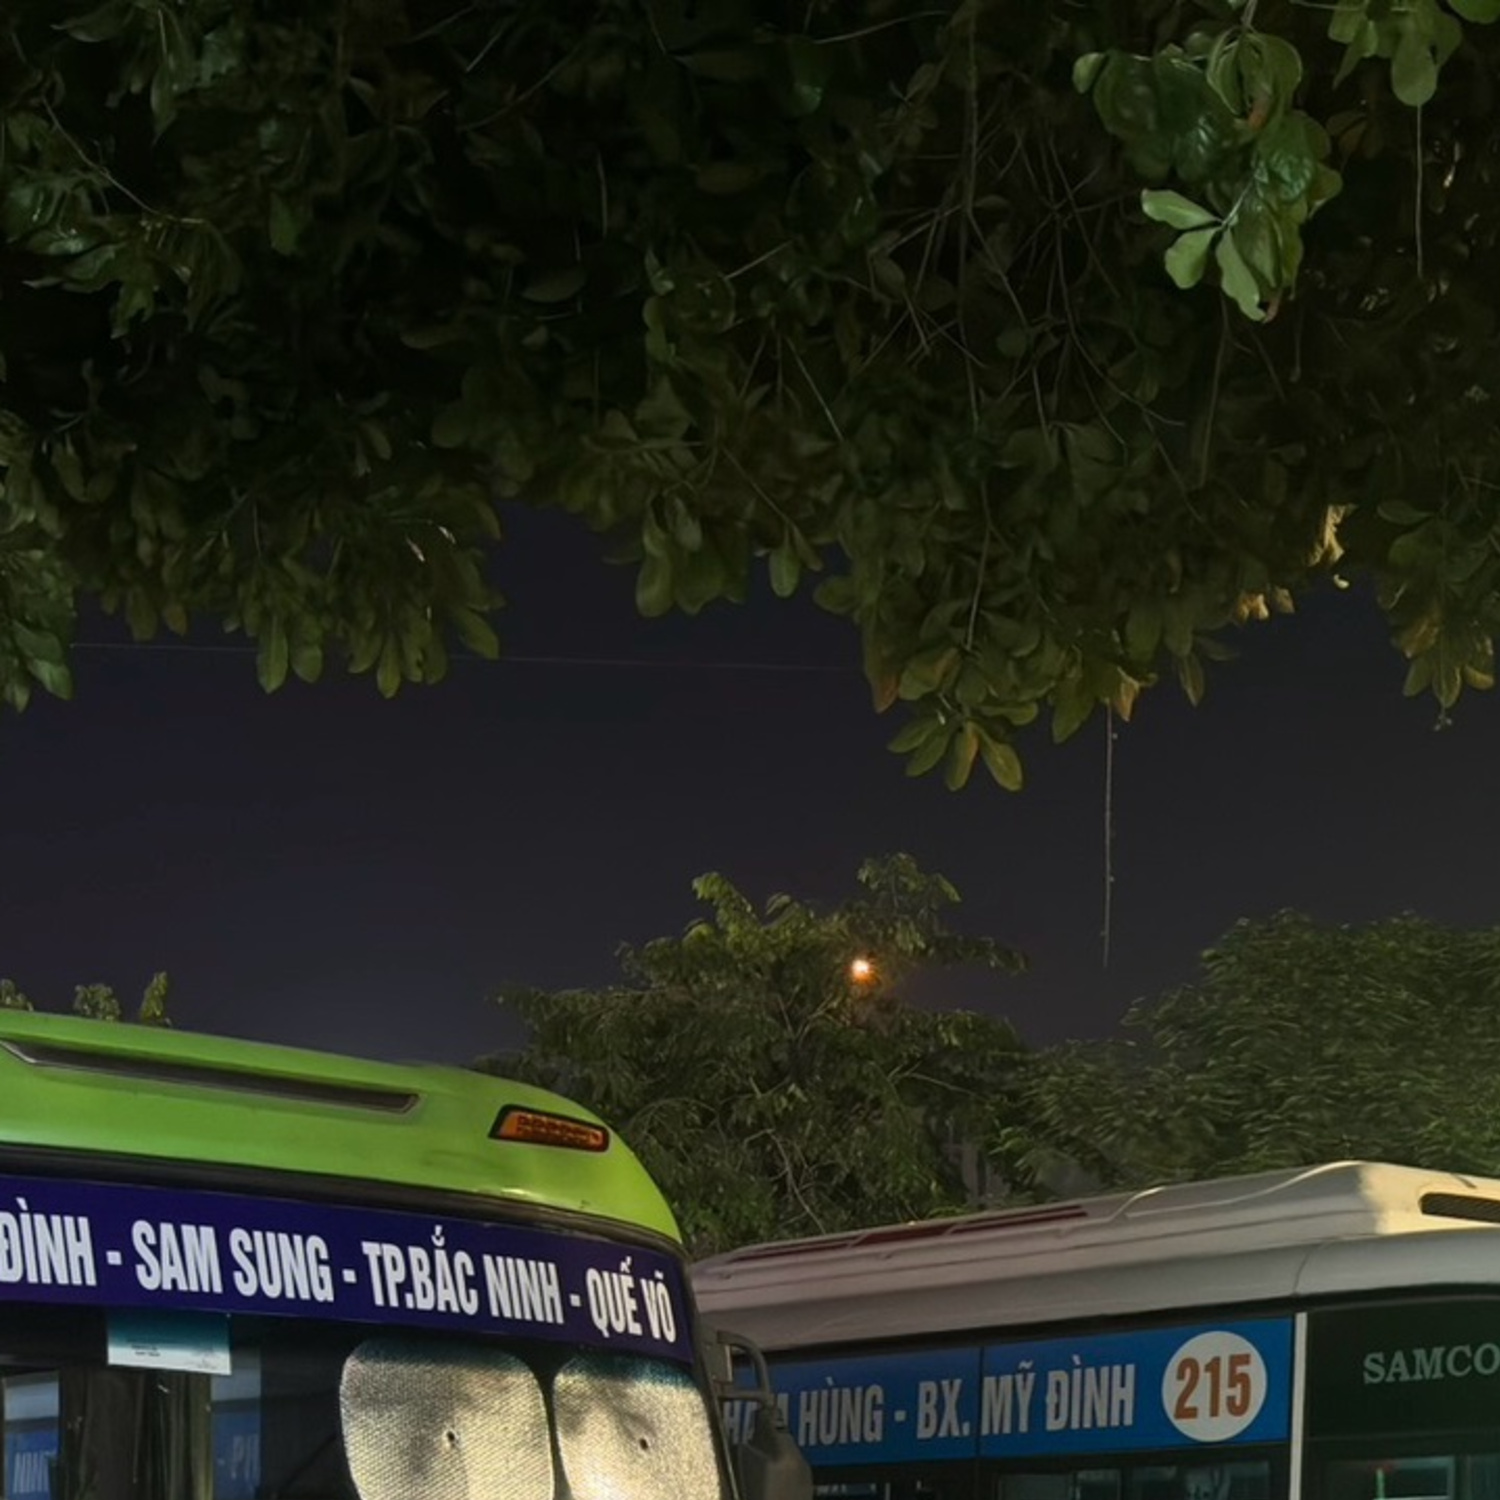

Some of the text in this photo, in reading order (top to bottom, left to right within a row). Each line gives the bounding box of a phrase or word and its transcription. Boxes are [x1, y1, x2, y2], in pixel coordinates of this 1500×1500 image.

[0, 1197, 97, 1286] ĐÌNH
[131, 1219, 223, 1294] SAM
[229, 1227, 334, 1302] SUNG
[482, 1253, 565, 1325] NINH
[586, 1256, 643, 1338] QUẾ
[640, 1270, 677, 1343] VÕ
[798, 1376, 884, 1447] HÙNG
[917, 1378, 970, 1440] BX.
[981, 1360, 1035, 1437] MỸ
[1045, 1354, 1136, 1431] ĐÌNH
[1173, 1353, 1252, 1420] 215
